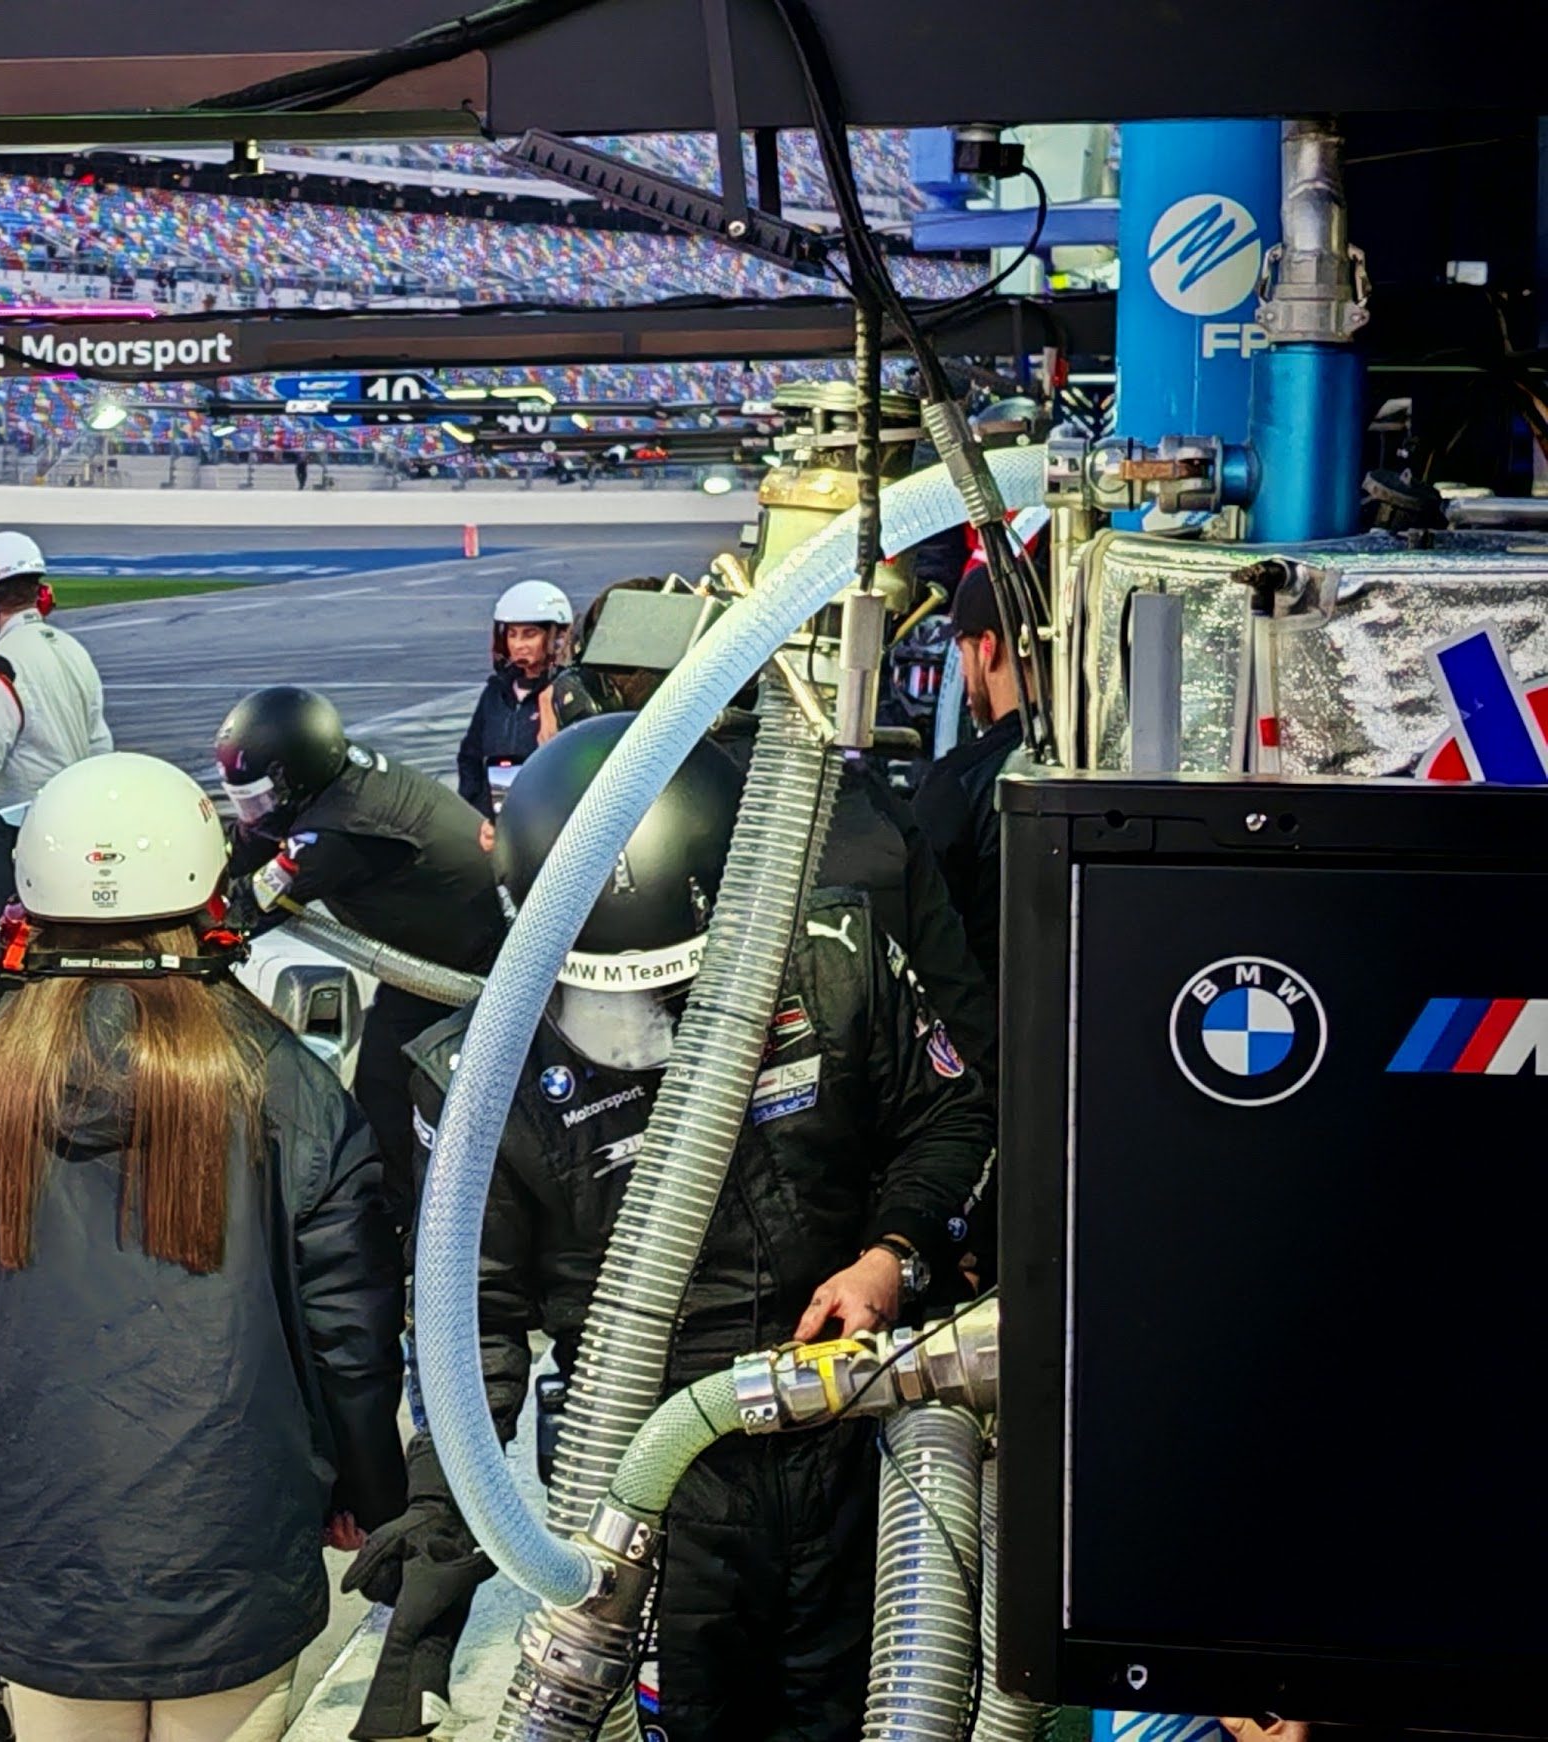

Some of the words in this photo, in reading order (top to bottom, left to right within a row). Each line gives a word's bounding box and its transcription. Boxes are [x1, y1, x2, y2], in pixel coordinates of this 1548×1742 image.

[21, 332, 232, 371] Motorsport
[92, 889, 119, 902] DOT
[604, 965, 623, 982] M
[626, 958, 684, 982] Team
[1191, 963, 1307, 1006] BMW
[562, 1085, 646, 1129] Motorsport
